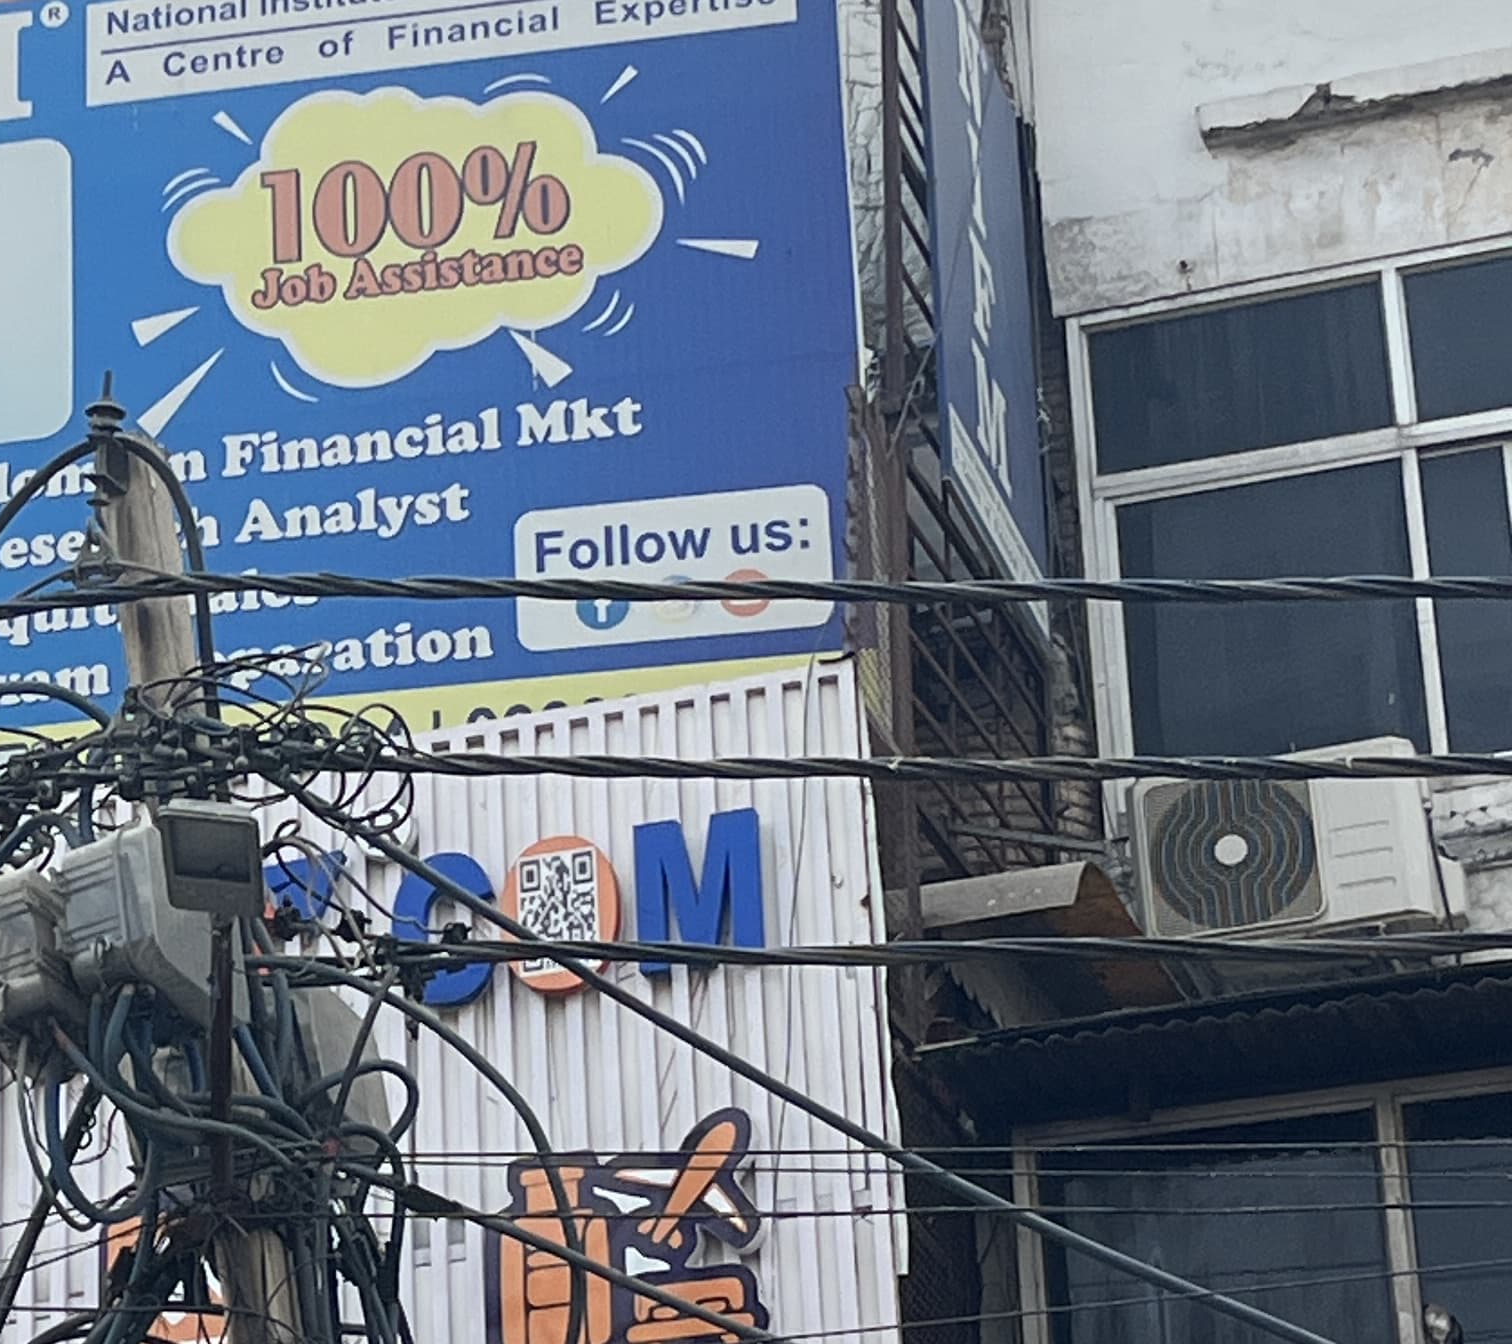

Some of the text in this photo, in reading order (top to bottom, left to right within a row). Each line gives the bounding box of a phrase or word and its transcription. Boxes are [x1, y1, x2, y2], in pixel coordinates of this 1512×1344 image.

[104, 59, 131, 87] A
[163, 40, 285, 80] Centre
[318, 30, 356, 60] of
[387, 6, 560, 52] Financial
[258, 139, 572, 266] 100%
[249, 240, 585, 309] Job Assistance
[221, 406, 504, 480] Financial
[515, 395, 644, 446] Mkt
[236, 481, 471, 545] Analyst
[533, 515, 812, 575] Follow us:
